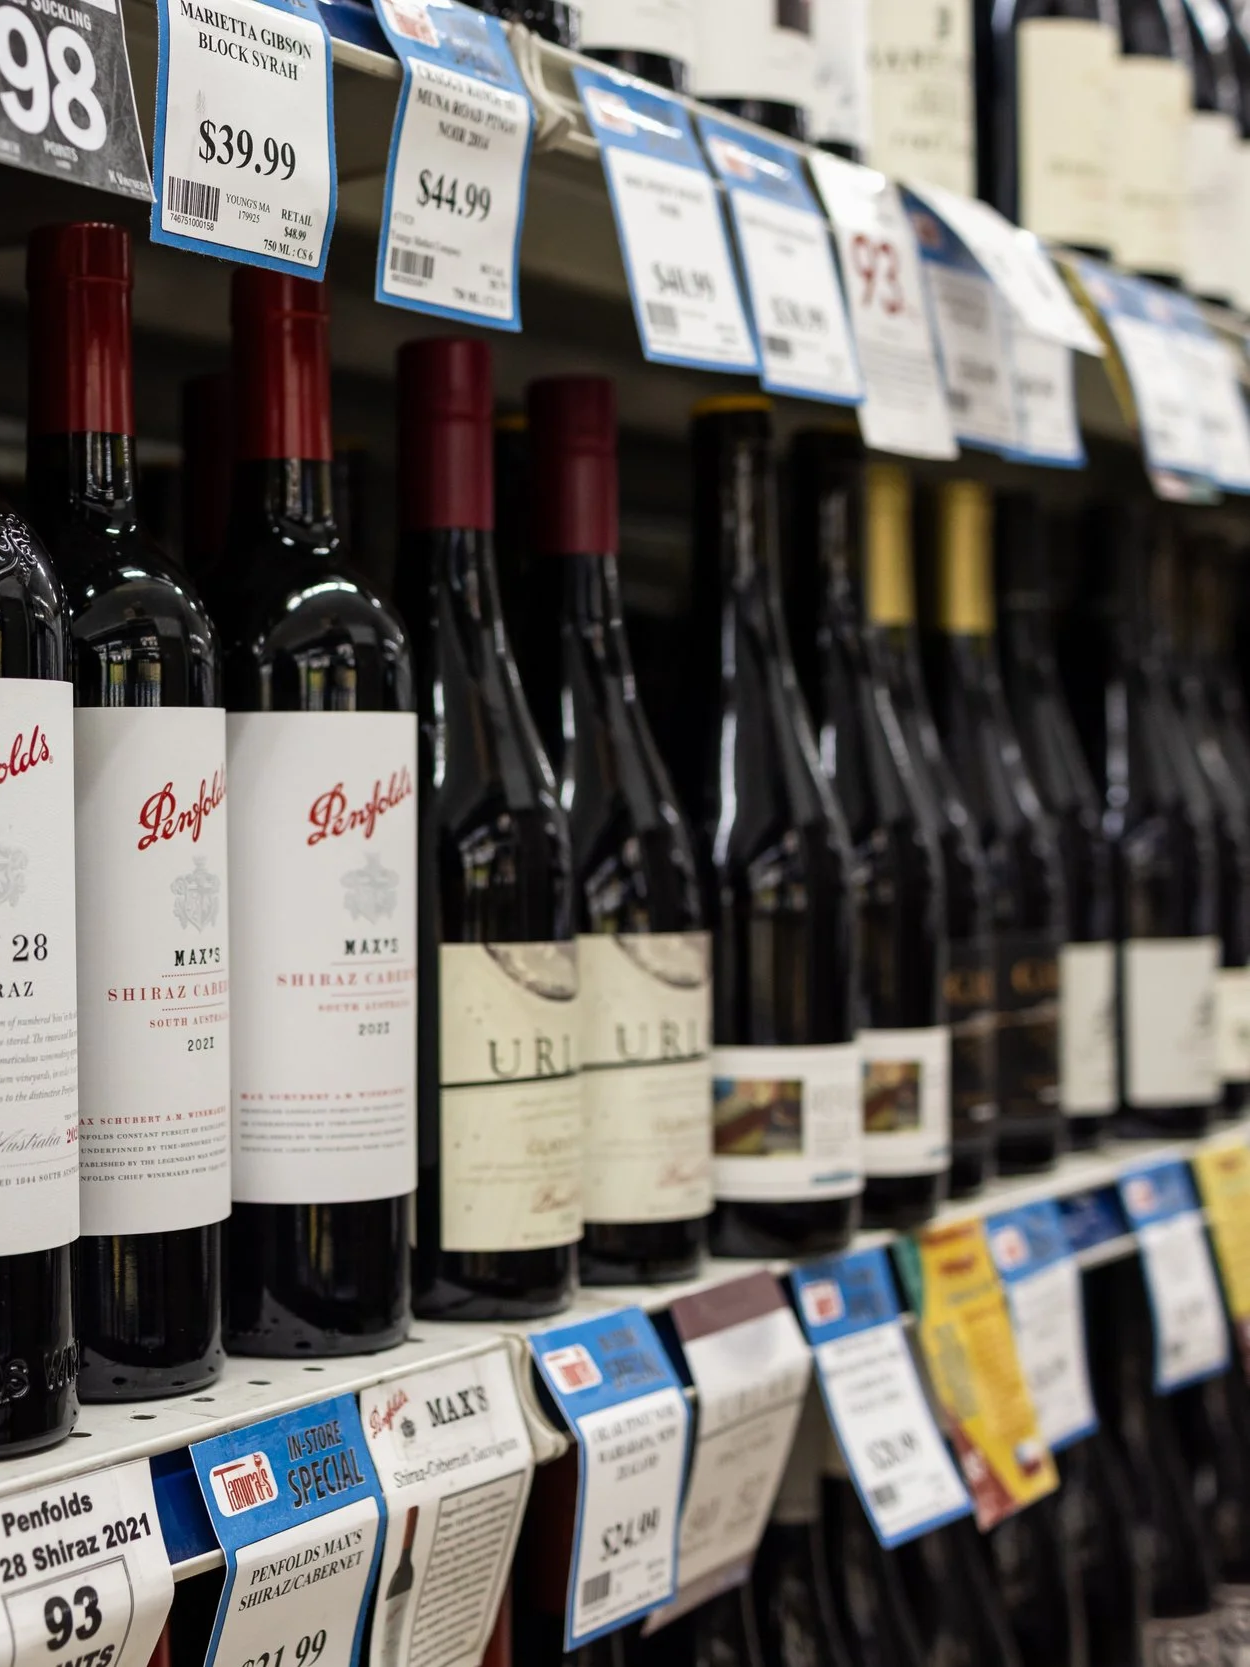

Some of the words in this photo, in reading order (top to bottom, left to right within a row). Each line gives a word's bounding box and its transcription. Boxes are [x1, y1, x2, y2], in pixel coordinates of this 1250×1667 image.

[180, 0, 257, 42] MARIETTA
[261, 28, 312, 60] GIBSON
[198, 31, 249, 64] BLOCK
[252, 50, 298, 81] SYRAH
[452, 100, 483, 123] ROAD
[438, 120, 465, 143] NOIR
[199, 119, 296, 181] $39.99
[225, 193, 258, 211] YOUNG'S
[258, 201, 271, 214] MA
[416, 168, 491, 222] $44.99
[238, 210, 260, 224] 179925
[281, 208, 313, 228] RETAIL
[284, 226, 307, 242] $48.99
[263, 239, 277, 252] 750
[279, 243, 291, 256] ML
[297, 247, 308, 260] CS
[851, 233, 902, 315] 93
[137, 763, 226, 851] Penfold
[12, 933, 48, 962] 28
[174, 947, 221, 967] MAX'S
[344, 938, 399, 956] MAX'S
[276, 972, 357, 987] SHIRAZ
[108, 985, 187, 1001] SHIRAZ
[7, 1015, 18, 1031] of
[150, 1017, 188, 1028] SOUTH
[5, 1094, 14, 1103] to
[14, 1091, 28, 1102] the
[78, 1117, 95, 1126] AX
[100, 1115, 161, 1125] SCHUBERT
[79, 1133, 114, 1141] NFOLDS
[116, 1131, 159, 1140] CONSTANT
[161, 1128, 190, 1138] PURSUIT
[80, 1146, 144, 1155] UNDERPINNED
[146, 1145, 157, 1153] BY
[79, 1160, 126, 1169] TABLISHED
[127, 1160, 138, 1168] BY
[140, 1159, 155, 1167] THE
[80, 1174, 115, 1182] NFOLDS
[118, 1173, 144, 1182] CHIEF
[146, 1168, 190, 1180] WINEMAKER
[426, 1385, 490, 1428] MAX'S
[286, 1419, 343, 1462] IN-STORE
[213, 1458, 274, 1514] Tamura's
[286, 1448, 366, 1510] SPECIAL
[1, 1492, 93, 1538] Penfolds
[0, 1554, 28, 1582] 28
[32, 1535, 100, 1572] Shiraz
[102, 1512, 152, 1550] 2021
[250, 1545, 322, 1586] PENFOLDS
[321, 1528, 363, 1557] MAX'S
[238, 1551, 365, 1612] SHIRAZ/CABERNET
[43, 1585, 102, 1652] 93
